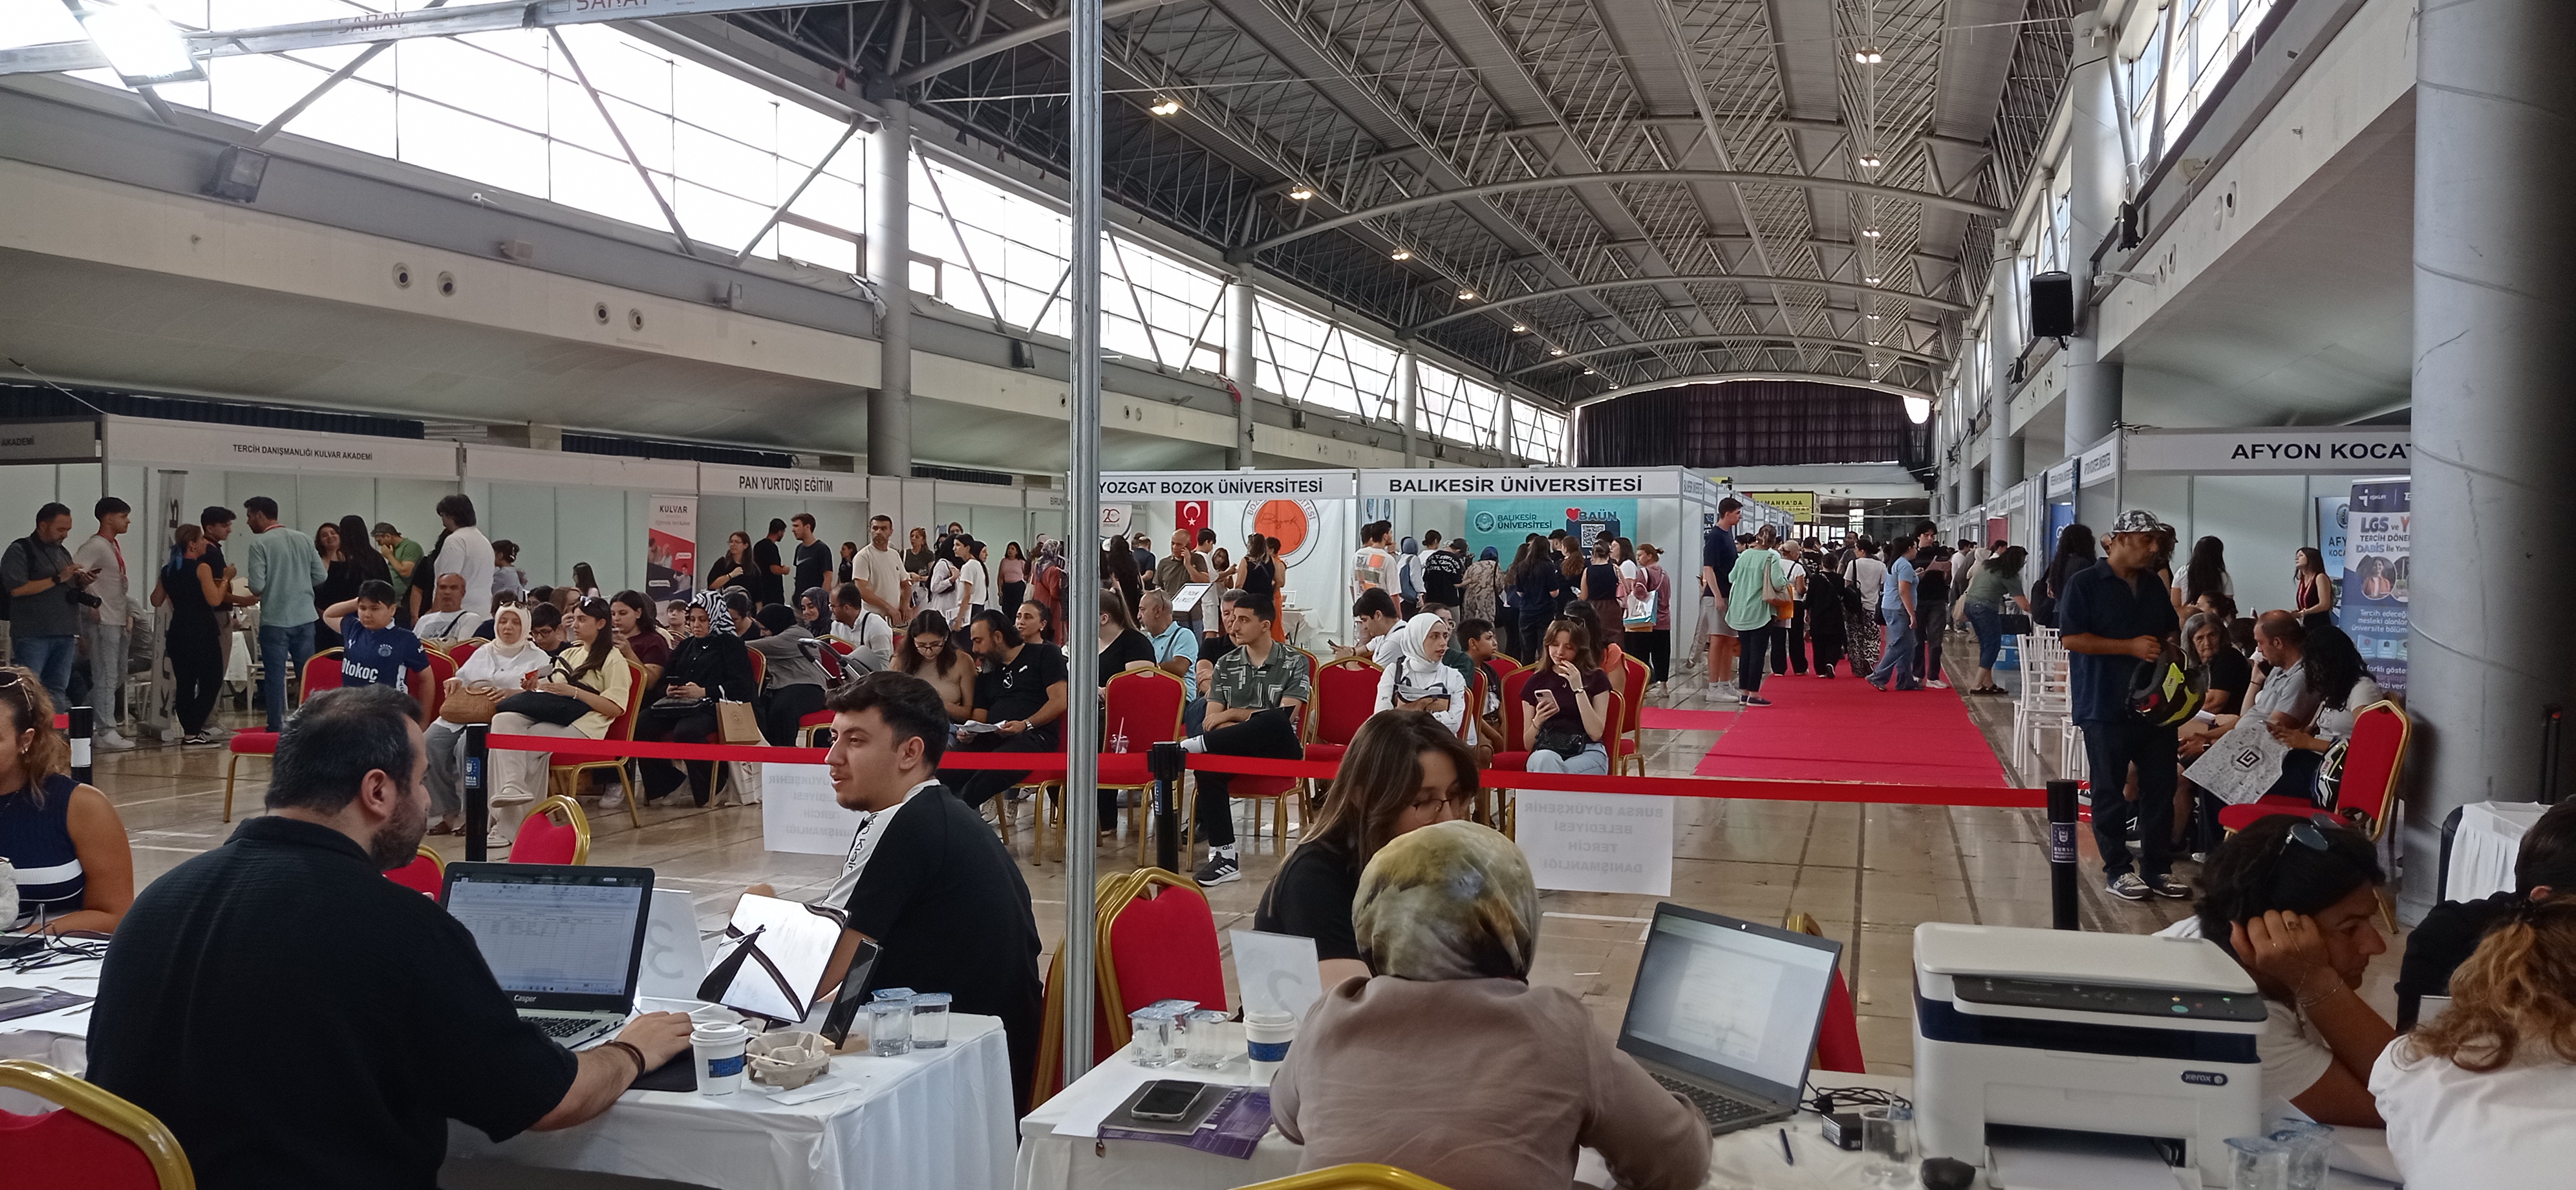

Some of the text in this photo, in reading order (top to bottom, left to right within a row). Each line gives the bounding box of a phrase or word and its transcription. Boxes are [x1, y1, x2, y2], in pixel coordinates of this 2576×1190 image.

[233, 444, 372, 460] TERCİH DANIŞMANLIĞI KULVAR AKADEMİ
[2231, 444, 2321, 459] AFYON
[739, 476, 833, 494] PAN YURTDIŞI EĞİTİM
[1099, 477, 1323, 494] YOZGAT BOZOK ÜNİVERSİTESİ
[1390, 475, 1642, 492] BALIKESİR ÜNİVERSİTESİ
[1579, 509, 1617, 521] BAÜN
[2361, 517, 2389, 533] LGS
[2360, 534, 2386, 542] TERCİH
[514, 995, 537, 1003] Casper
[2185, 1074, 2211, 1083] xerox
